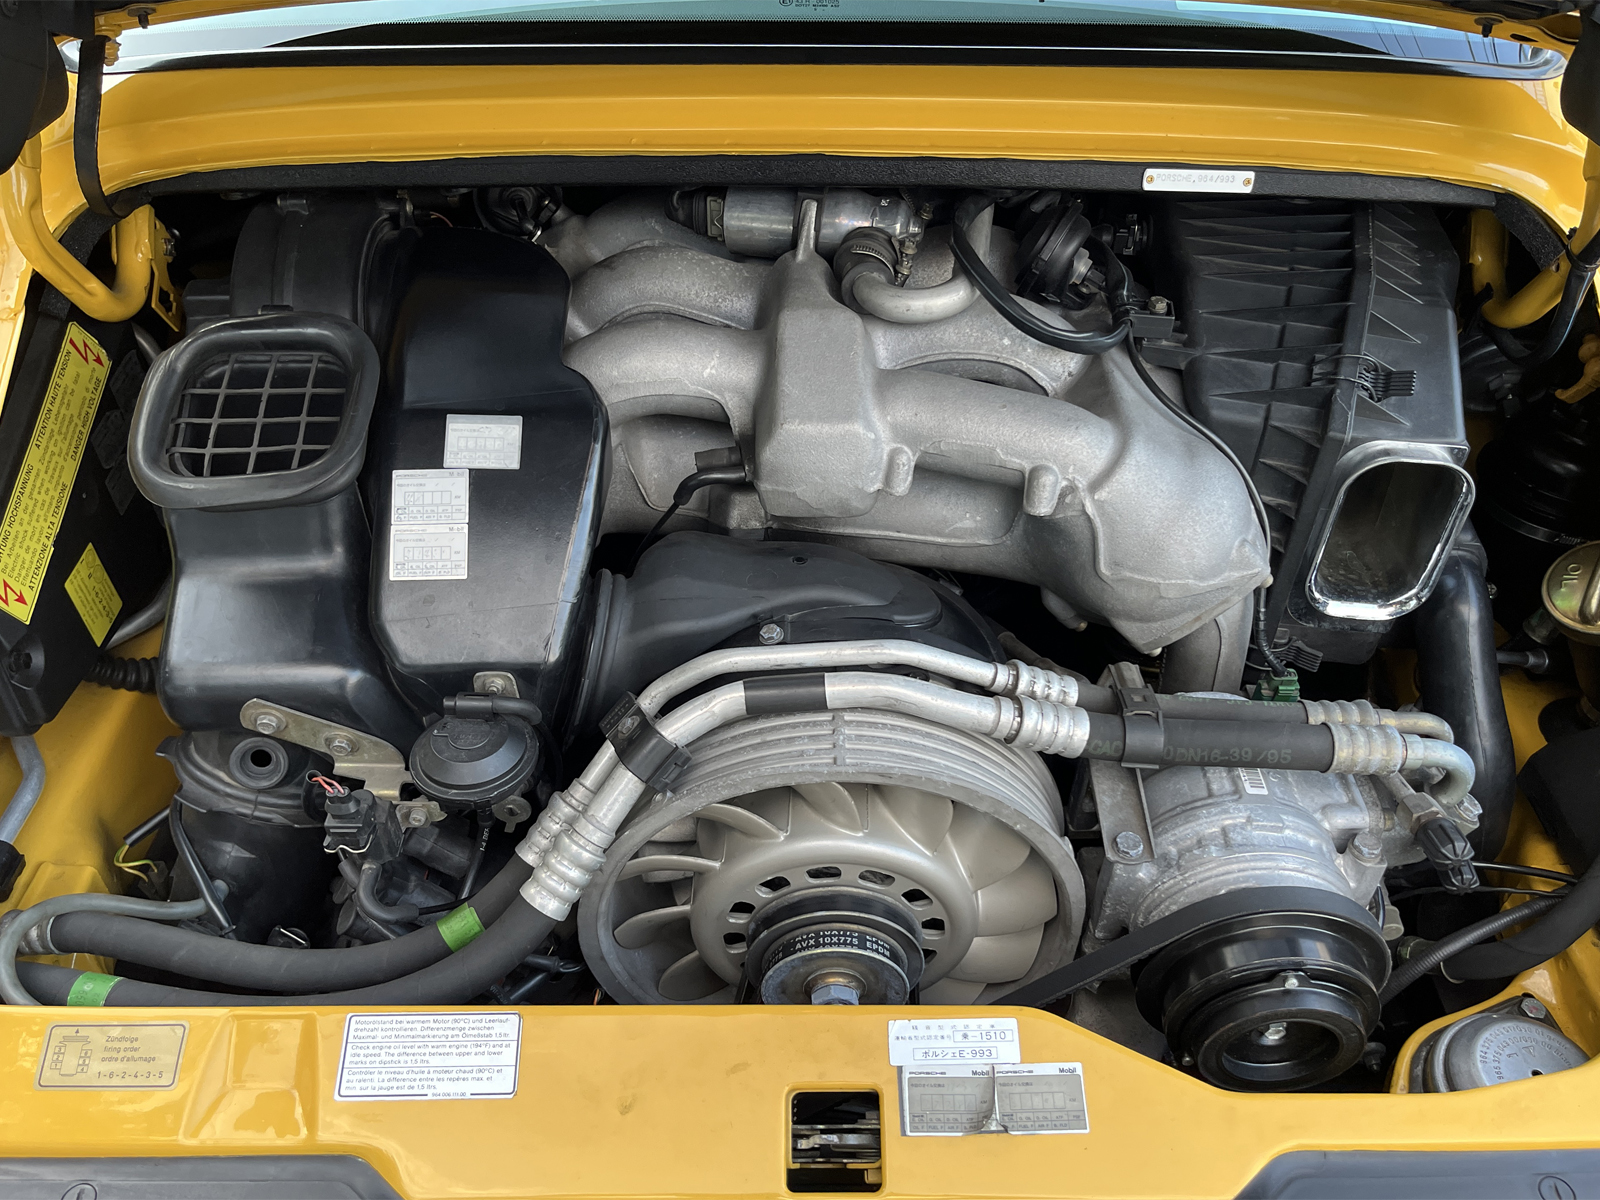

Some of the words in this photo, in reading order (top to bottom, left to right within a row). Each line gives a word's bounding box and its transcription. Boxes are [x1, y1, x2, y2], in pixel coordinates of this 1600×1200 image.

[34, 406, 52, 449] ATTENTION
[48, 380, 61, 407] HAUTE
[57, 349, 72, 382] TENSION
[70, 429, 84, 462] DANGER
[80, 409, 91, 430] HIGH
[86, 375, 102, 410] VOLTAGE
[7, 462, 34, 528] HOCHSPANNUNG
[28, 541, 48, 592] ATTENZIONE
[44, 519, 56, 541] ALTA
[51, 480, 68, 519] TENSIONE
[1560, 564, 1582, 591] OIL
[819, 936, 858, 944] 10X775
[866, 941, 890, 957] EPDM
[106, 1035, 138, 1043] Zündfolge
